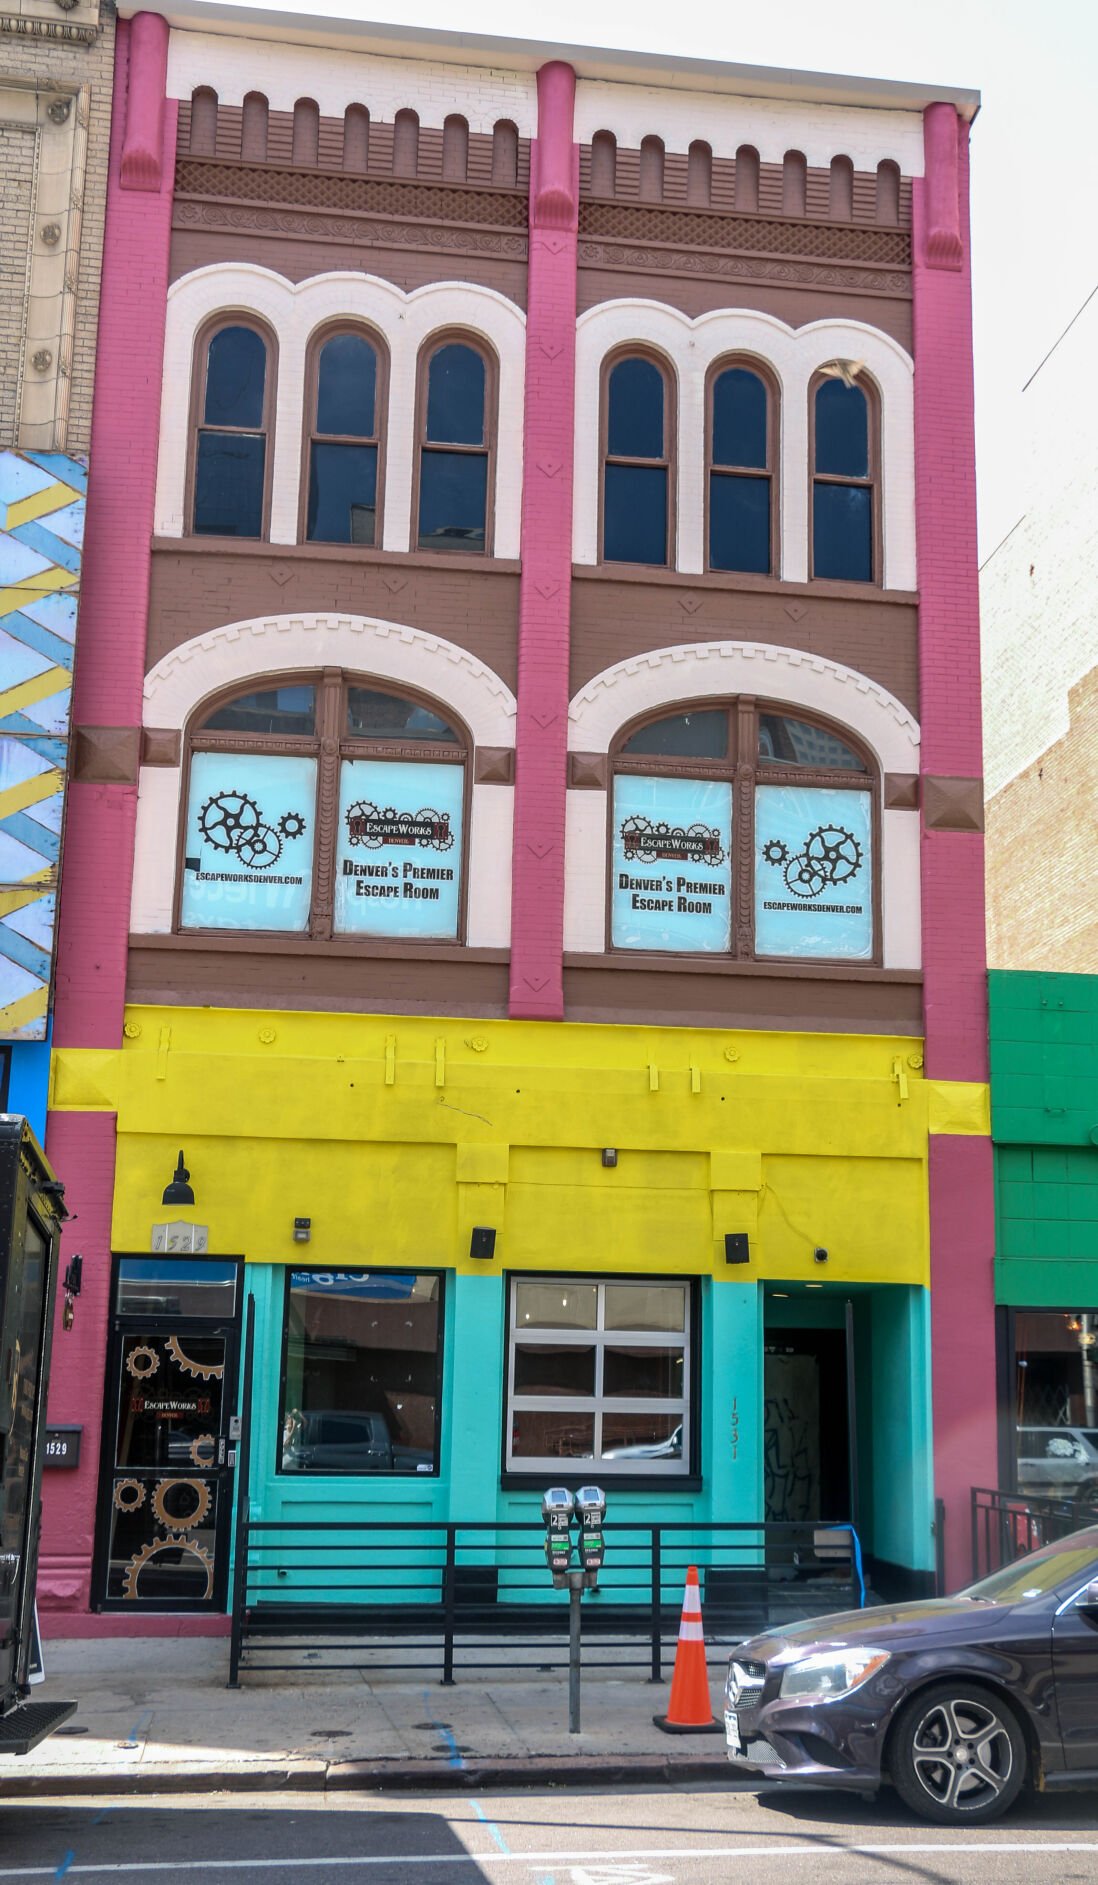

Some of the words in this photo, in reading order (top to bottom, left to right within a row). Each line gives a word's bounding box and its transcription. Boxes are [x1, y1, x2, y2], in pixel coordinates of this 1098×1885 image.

[366, 823, 432, 835] ESCAPEWORKS
[640, 837, 703, 850] ESCAPEWORKS
[343, 860, 399, 878] DENVER'S
[402, 862, 453, 880] PREMIER
[195, 872, 303, 885] ESCAPEWORKSDENVER.COM
[618, 874, 673, 892] DENVER'S
[676, 877, 726, 895] PREMIER
[356, 880, 399, 898] ESCAPE
[403, 882, 439, 899] ROOM
[631, 894, 674, 911] ESCAPE
[677, 896, 712, 913] ROOM
[763, 901, 863, 914] ESCAPEWORKSDENVER.COM
[153, 1235, 207, 1251] 1529
[144, 1400, 197, 1410] ESCAPEWORKS
[46, 1442, 67, 1455] 1529
